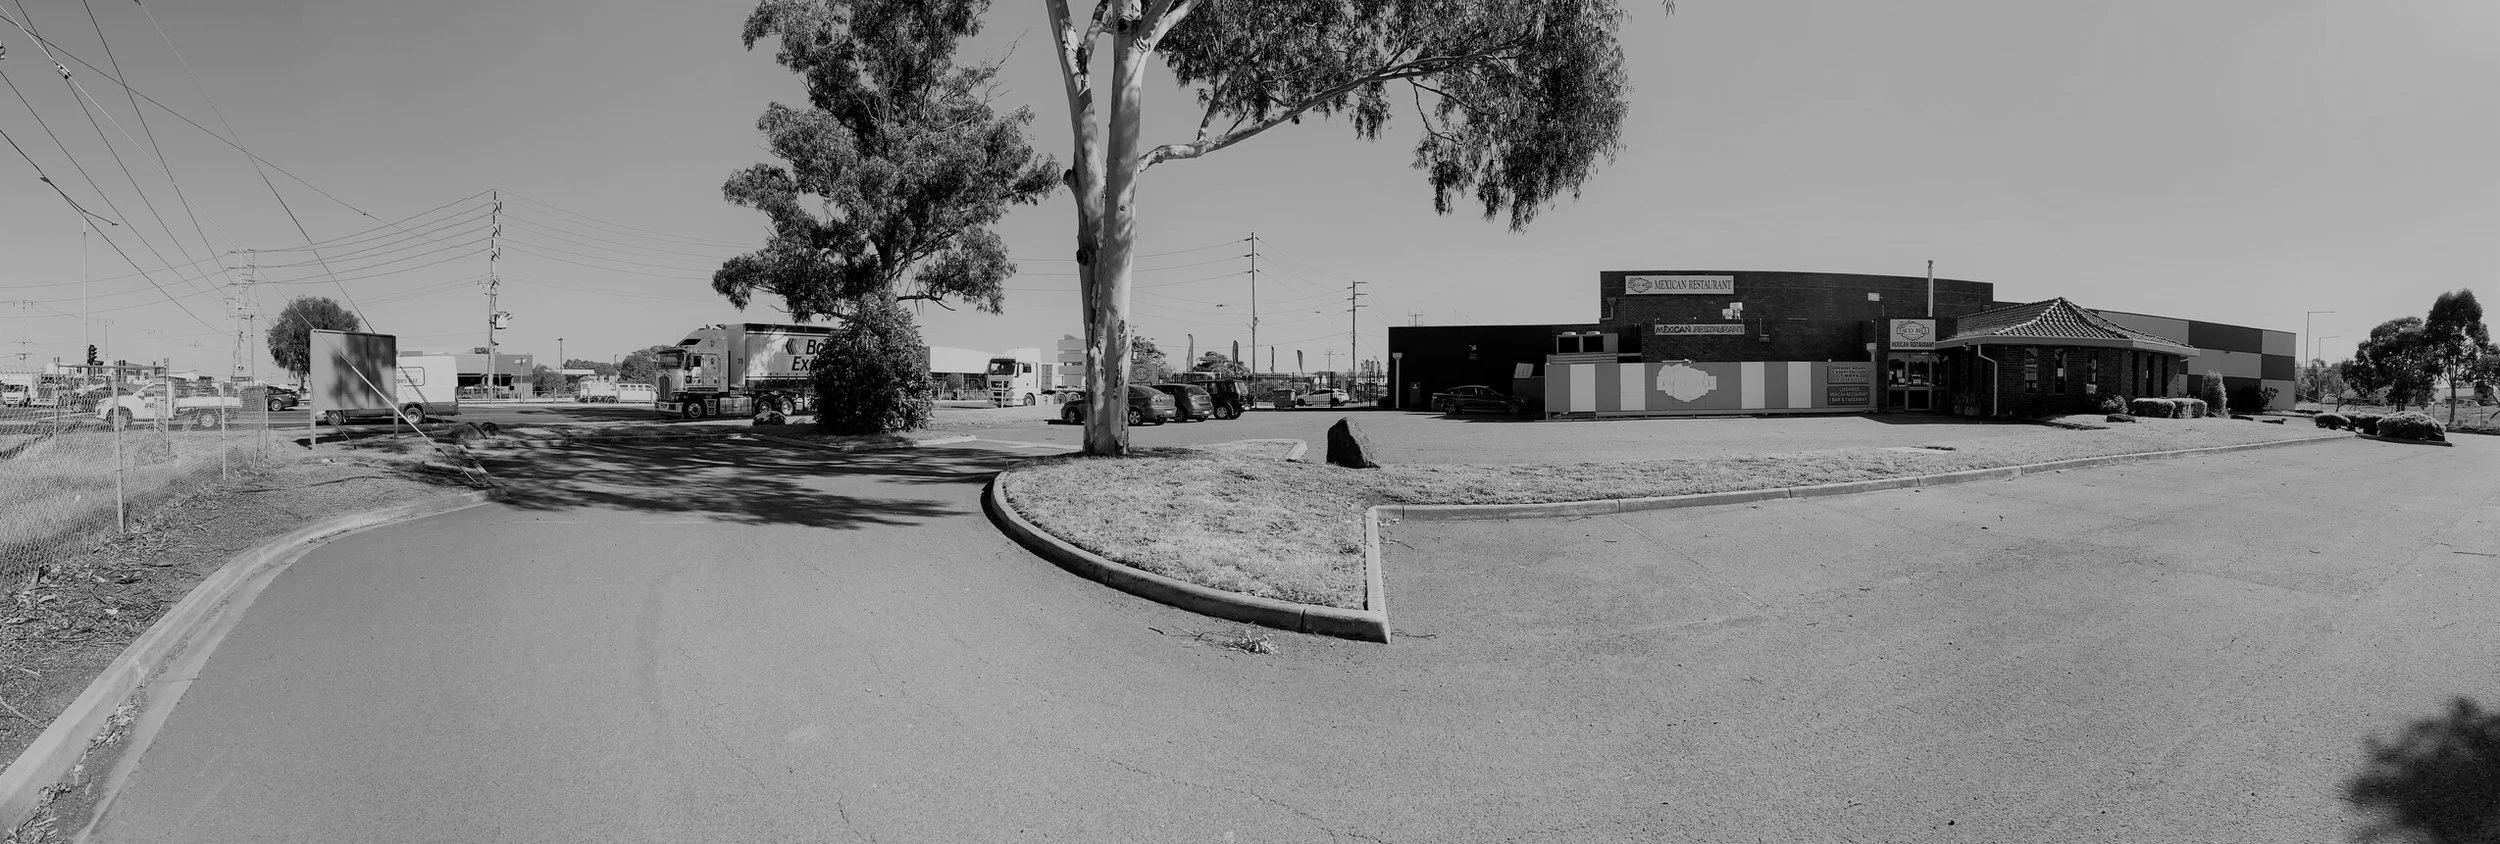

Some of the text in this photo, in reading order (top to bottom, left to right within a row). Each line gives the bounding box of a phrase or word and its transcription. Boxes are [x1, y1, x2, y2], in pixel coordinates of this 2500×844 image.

[1654, 280, 1732, 289] MEXICAN RESTAURANT
[1656, 325, 1691, 333] MEXICAN
